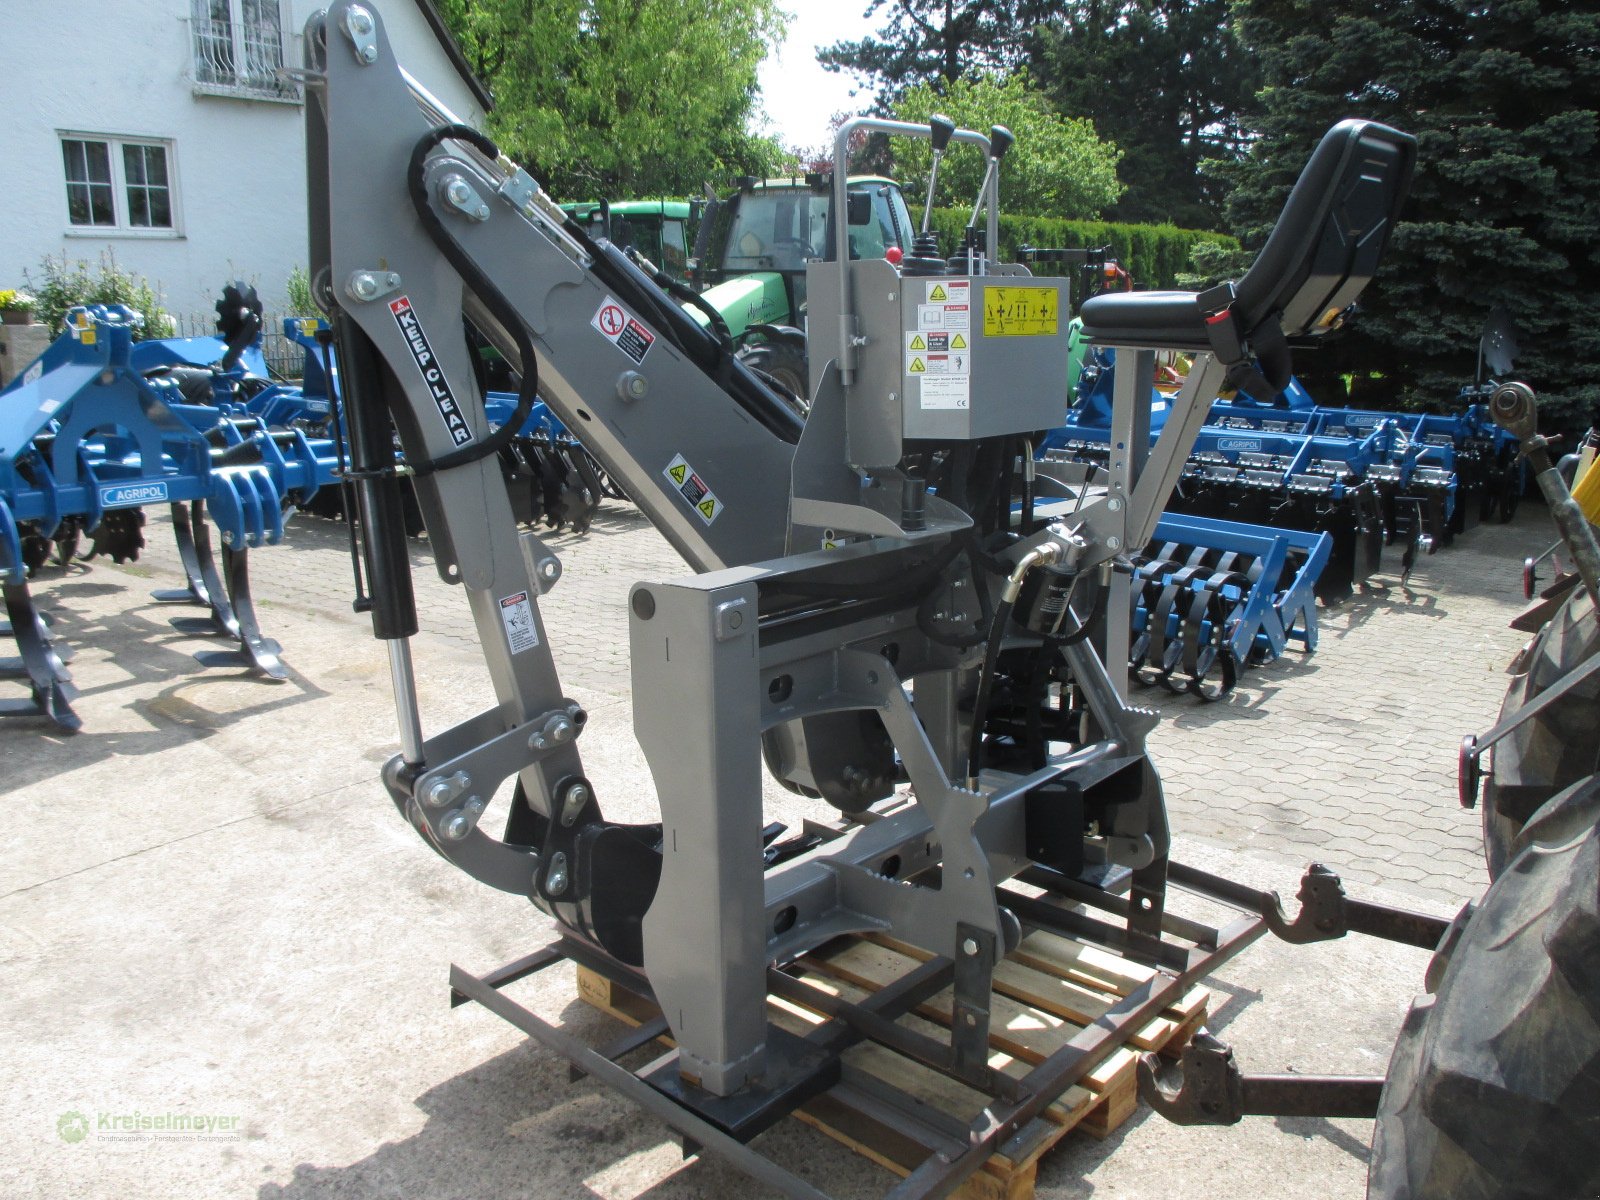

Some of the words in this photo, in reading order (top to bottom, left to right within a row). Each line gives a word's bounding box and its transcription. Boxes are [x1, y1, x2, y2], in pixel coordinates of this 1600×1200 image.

[635, 325, 652, 341] DANGER
[399, 311, 431, 367] KEEP
[426, 368, 468, 443] CLEAR
[1227, 441, 1259, 449] AGRIPOL
[116, 486, 165, 501] AGRIPOL
